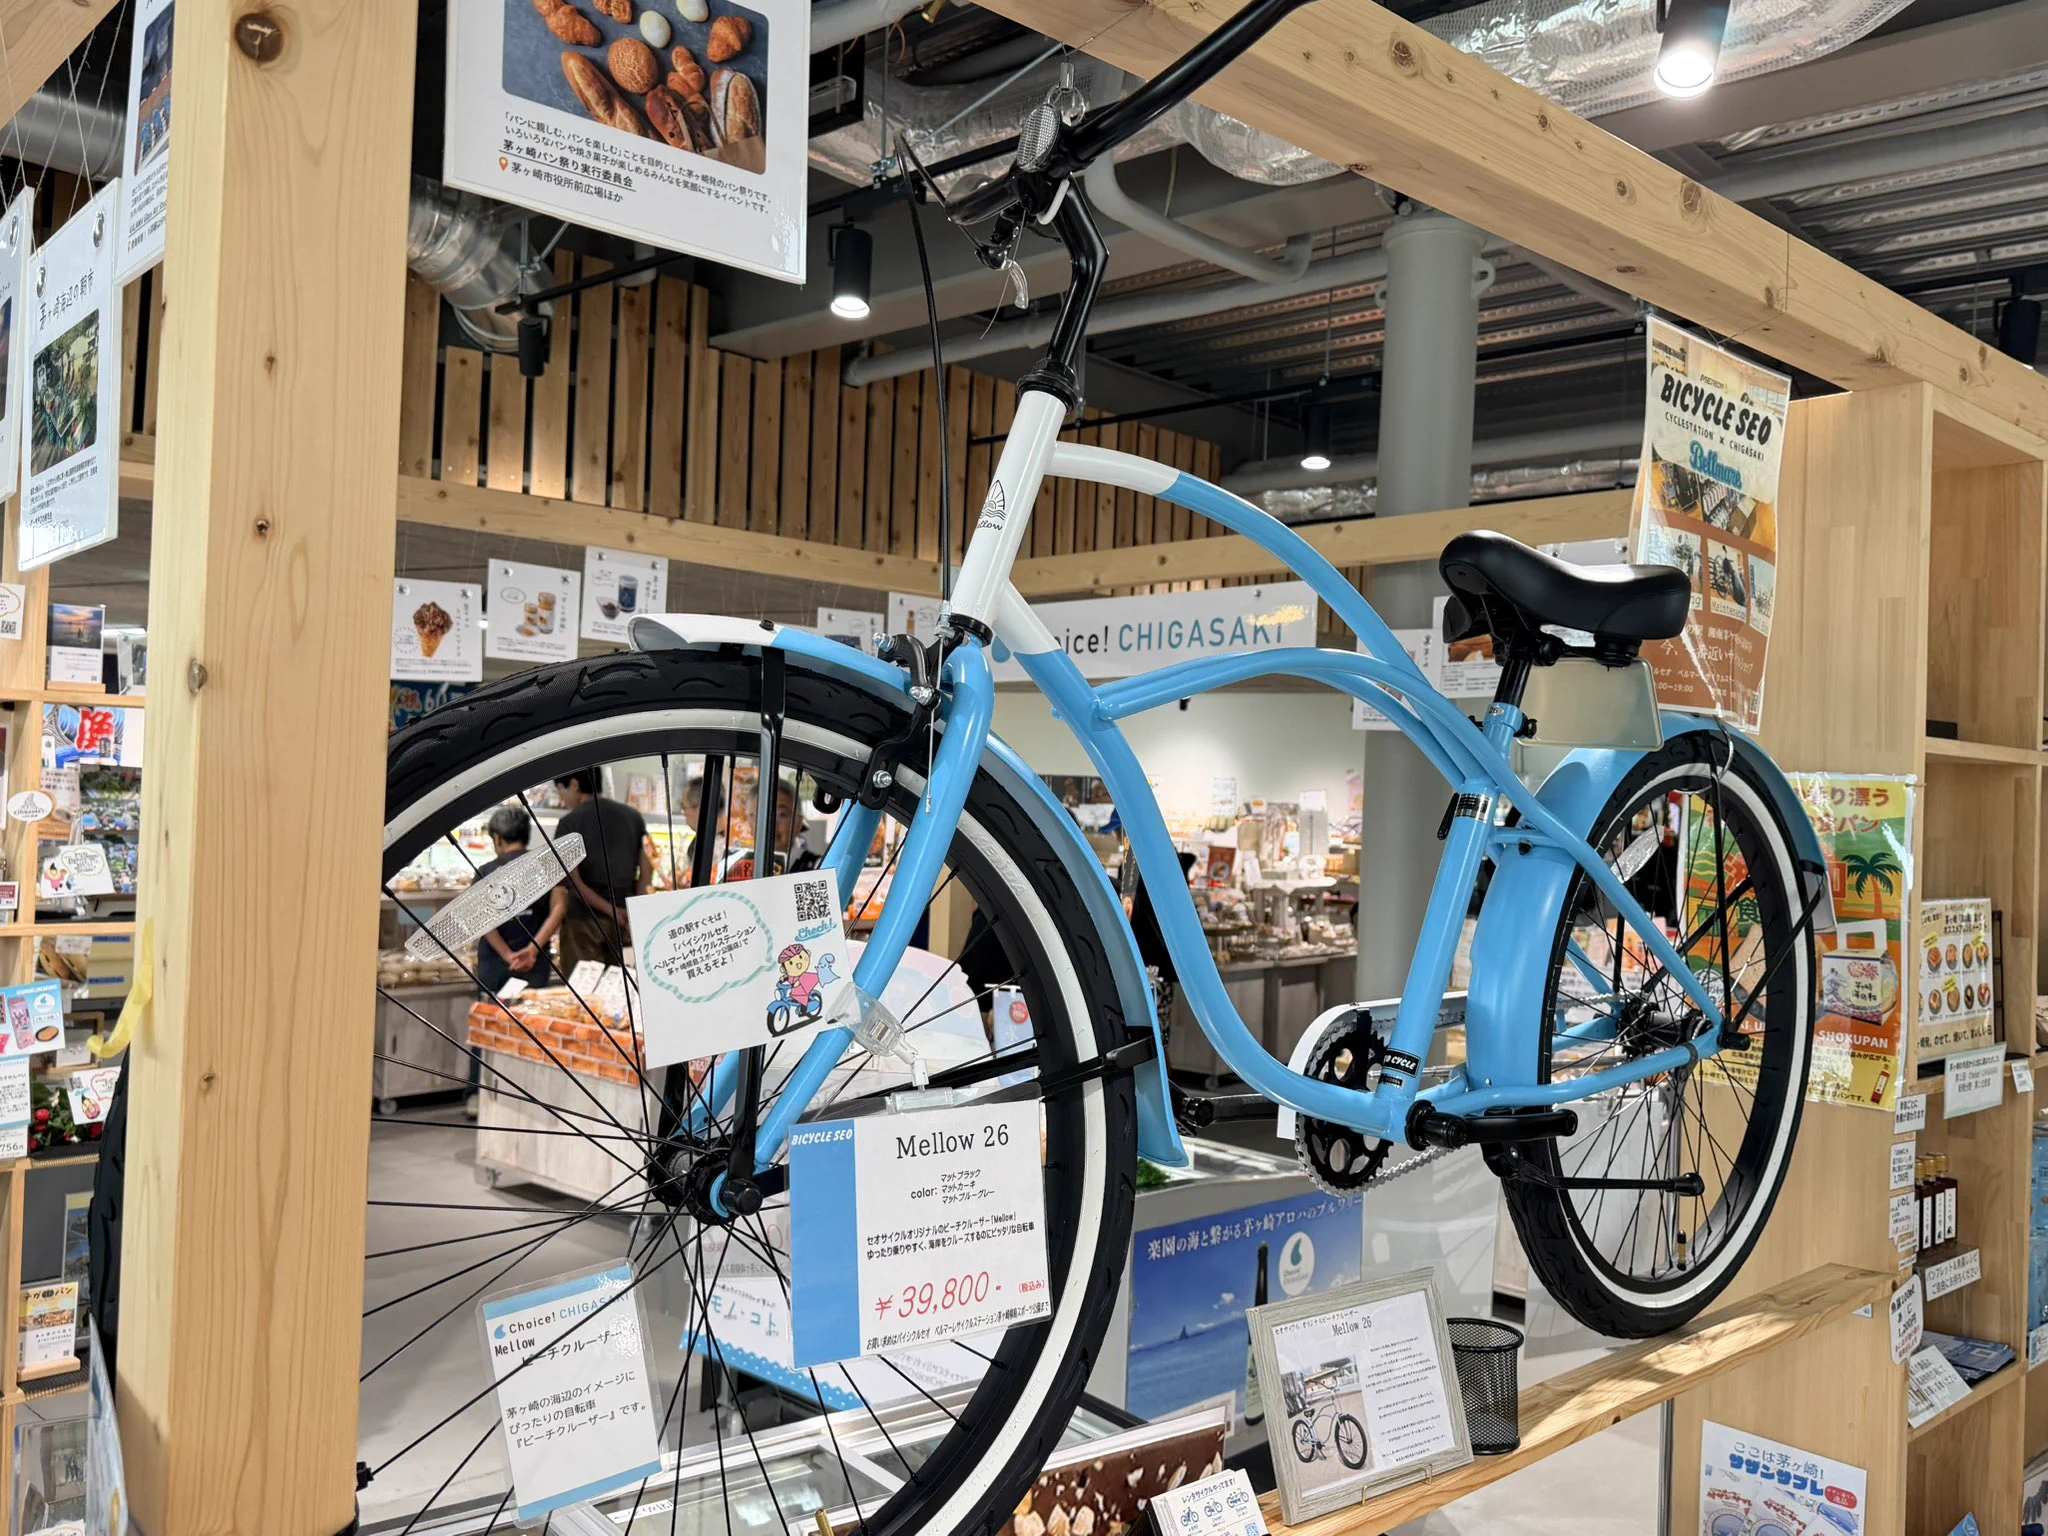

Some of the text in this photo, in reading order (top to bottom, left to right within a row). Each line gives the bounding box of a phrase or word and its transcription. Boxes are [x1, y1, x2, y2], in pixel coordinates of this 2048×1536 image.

[503, 139, 633, 187] 茅ヶ崎パン祭り実行委員会
[511, 162, 624, 203] 茅ヶ崎市役所前広場ほか
[1660, 373, 1772, 446] BICYCLE SEO
[1665, 411, 1714, 440] CYCLESTATION
[1729, 440, 1765, 461] CHIGASAKI
[1689, 440, 1743, 489] Bellmare
[653, 925, 757, 971] ベルマーレサイクルステーション
[1818, 1029, 1889, 1050] SHOKUPAN
[1390, 1056, 1417, 1071] CYCLE
[791, 1128, 854, 1145] BICYCLE SEO
[896, 1124, 1010, 1159] Mellow 26
[941, 1169, 981, 1182] マットブラック
[910, 1186, 938, 1199] color:
[941, 1181, 976, 1194] マットカーキ
[941, 1190, 995, 1205] マットブルーグレー
[1018, 1280, 1046, 1294] (税込み)
[509, 1312, 557, 1335] Choice!
[1332, 1315, 1373, 1337] Mellow 26
[494, 1337, 536, 1357] Mellow
[505, 1370, 636, 1419] 茅ヶ崎の海辺のイメージに
[508, 1399, 597, 1436] ぴったりの自転車
[1733, 1441, 1825, 1480] ここは茅ヶ崎!
